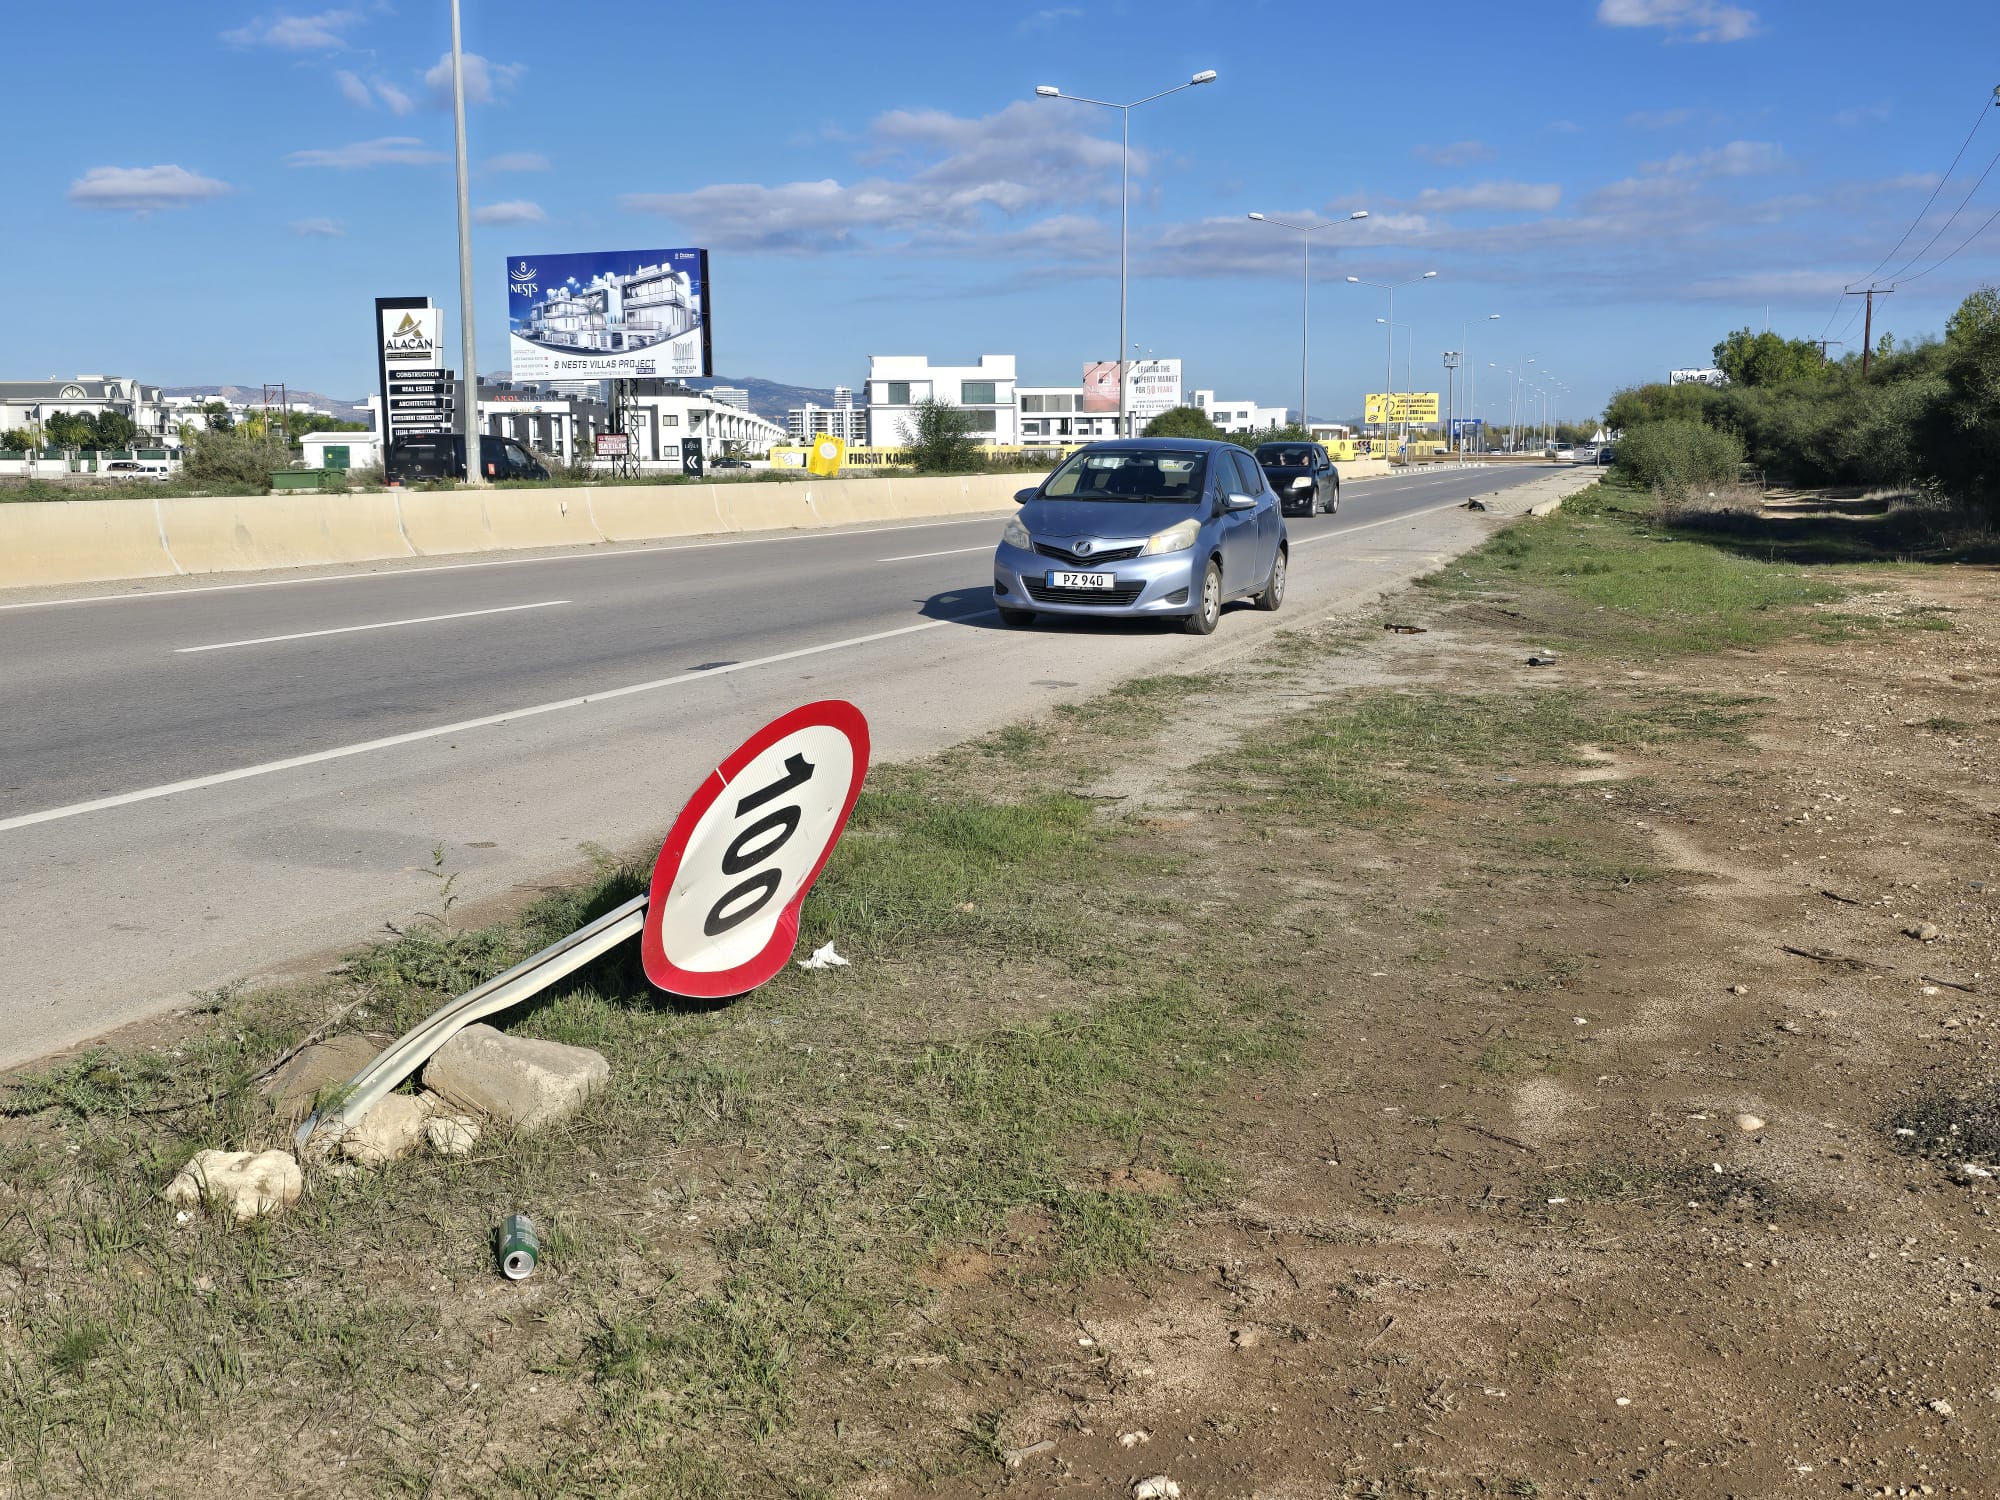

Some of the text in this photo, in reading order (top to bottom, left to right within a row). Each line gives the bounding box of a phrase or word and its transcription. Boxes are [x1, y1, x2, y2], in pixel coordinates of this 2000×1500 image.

[520, 261, 526, 273] 8
[510, 283, 538, 298] NESTS
[385, 338, 433, 350] ALACAN
[561, 360, 588, 369] NESTS
[589, 360, 617, 369] VILLAS
[618, 359, 656, 368] PROJECT
[1137, 364, 1171, 373] LEADING THE
[1130, 375, 1178, 384] PROPERTY MARKET
[1135, 386, 1146, 394] FOR
[848, 453, 883, 465] FIRSAT
[1063, 574, 1104, 587] PZ 940
[704, 752, 815, 936] 100
